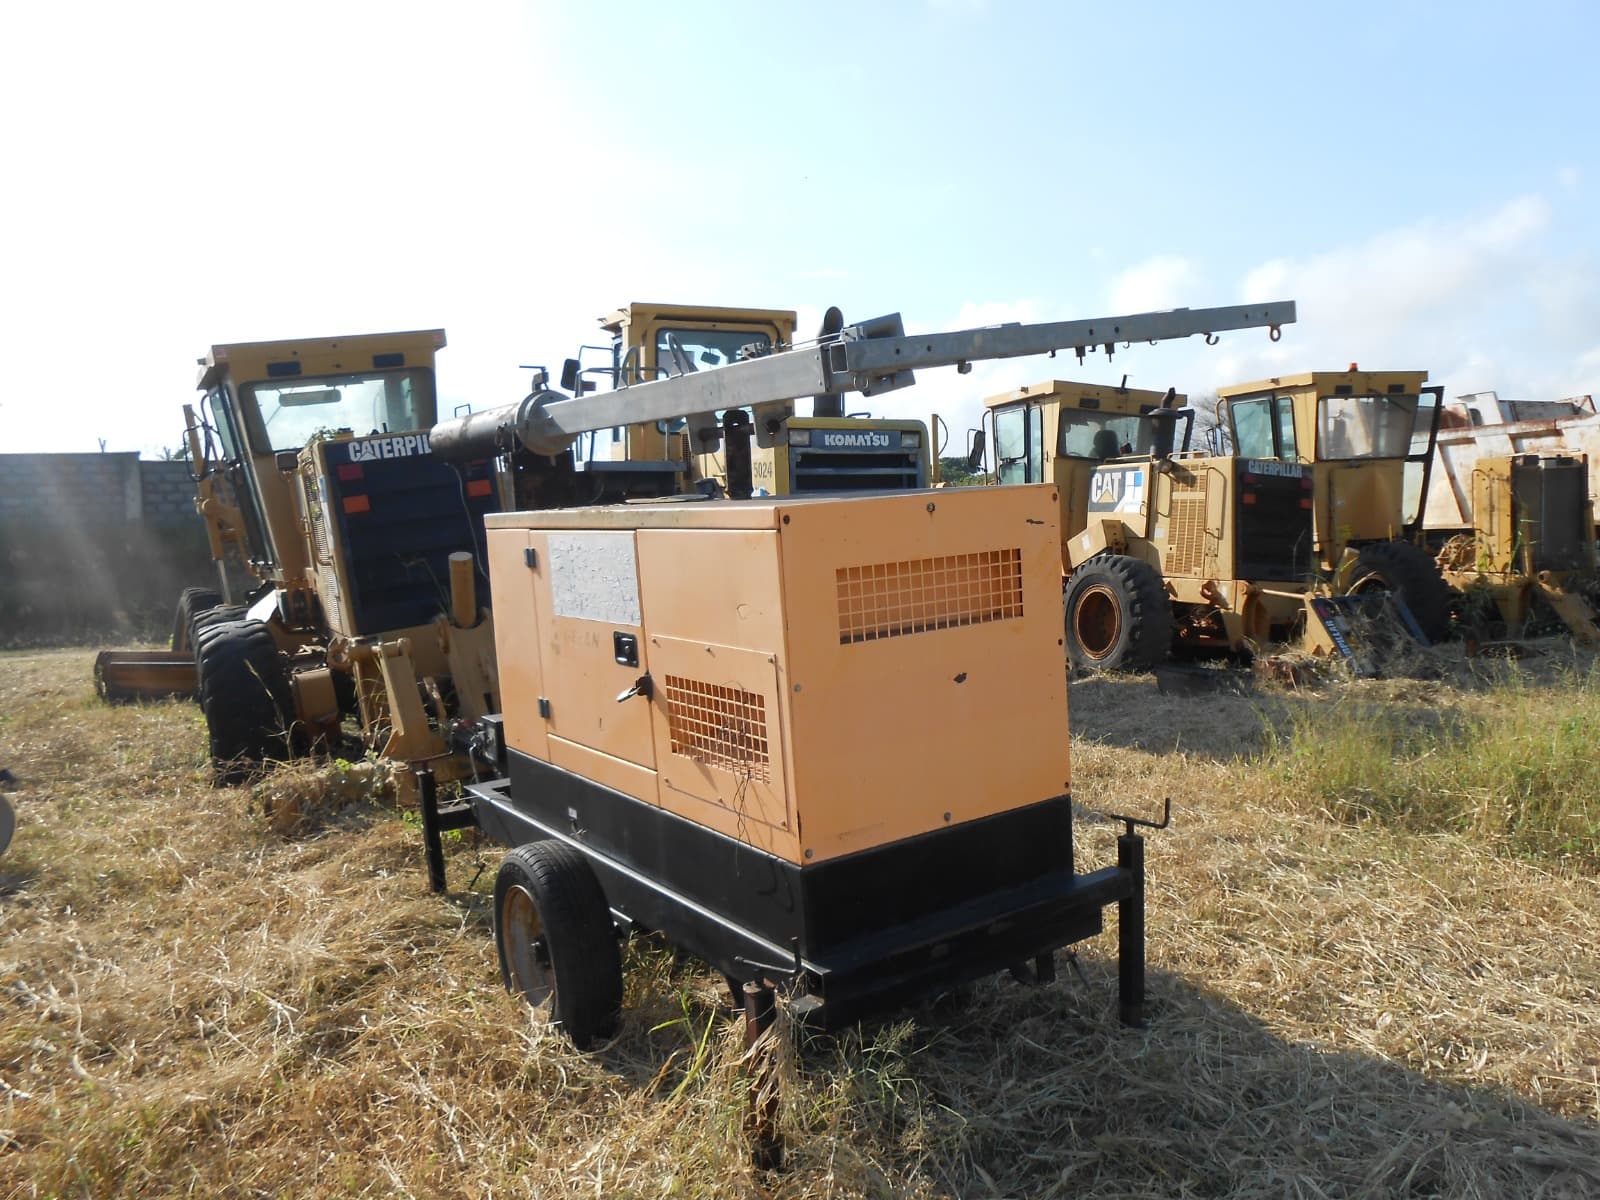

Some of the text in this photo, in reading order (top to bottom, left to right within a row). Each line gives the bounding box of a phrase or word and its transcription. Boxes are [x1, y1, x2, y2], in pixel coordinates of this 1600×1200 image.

[348, 434, 432, 462] CATERPIL
[824, 431, 890, 446] KOMATSU
[753, 461, 773, 479] 5024
[1248, 459, 1303, 478] CATERPILLAR
[1091, 471, 1122, 504] CAT
